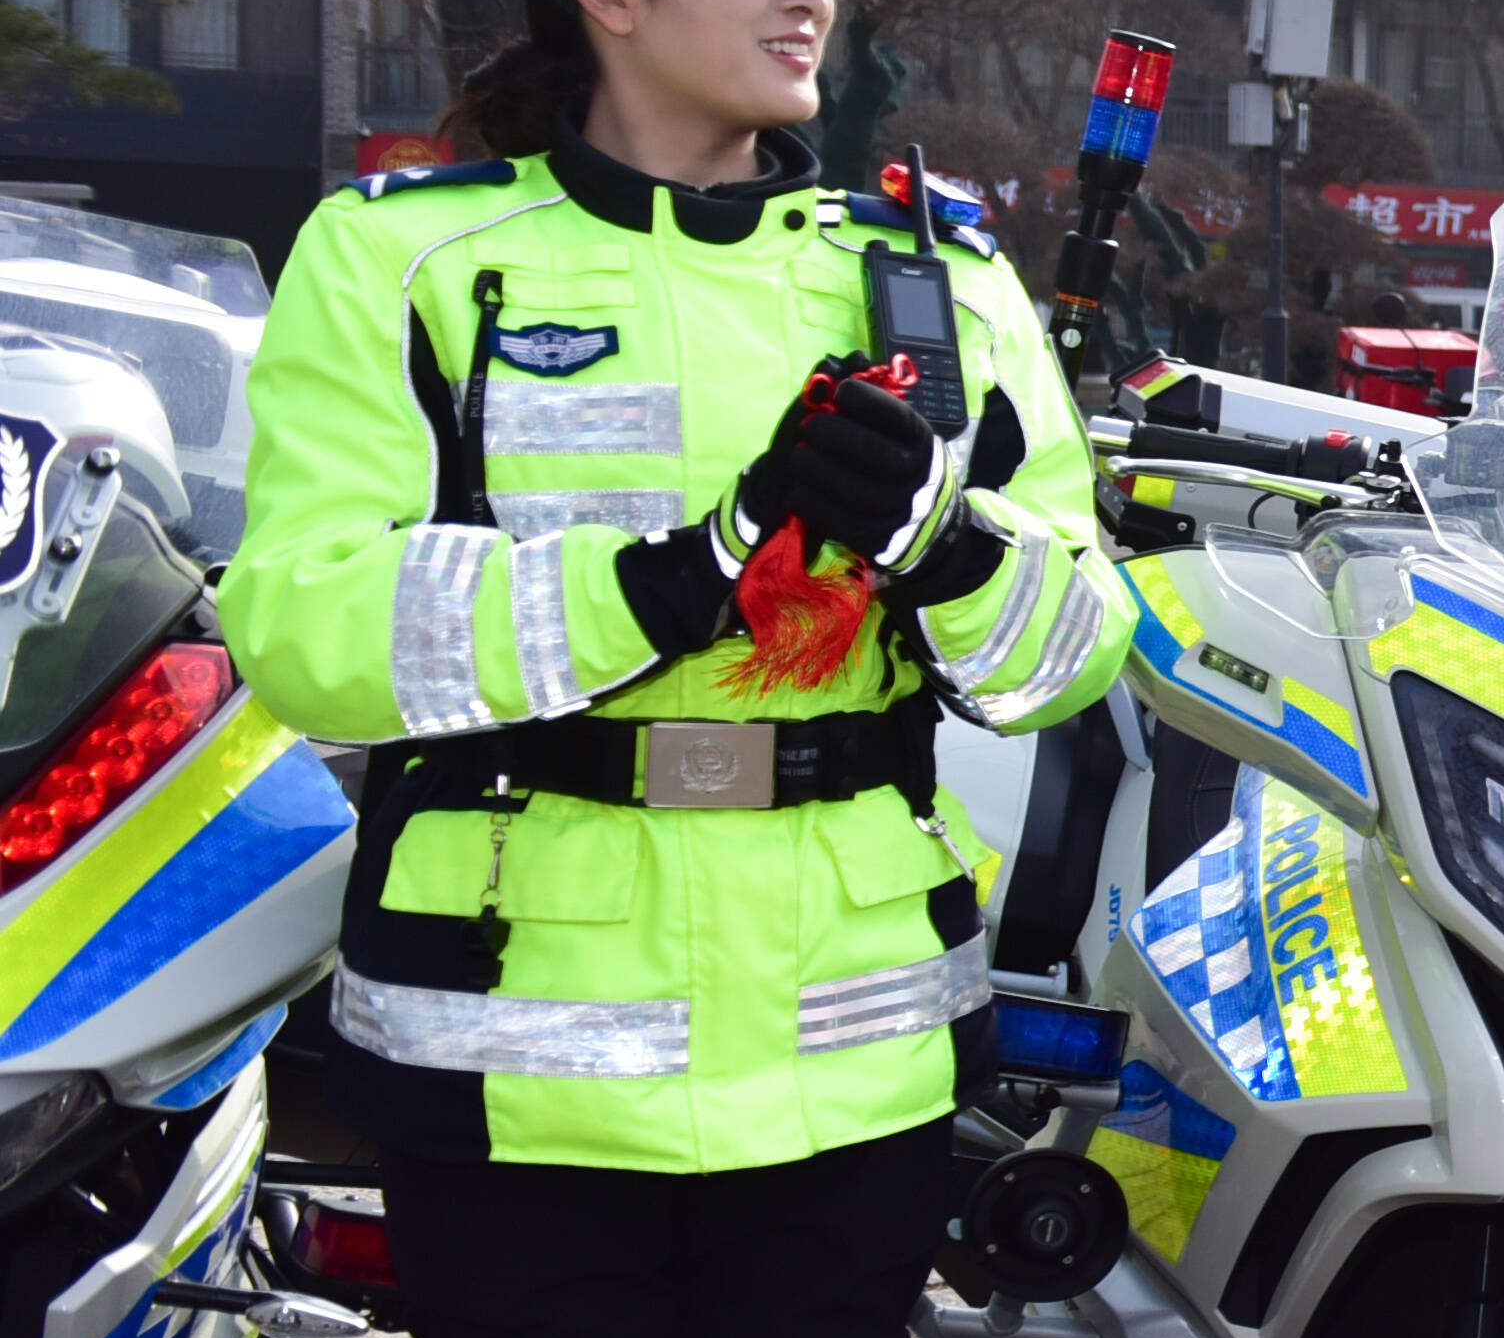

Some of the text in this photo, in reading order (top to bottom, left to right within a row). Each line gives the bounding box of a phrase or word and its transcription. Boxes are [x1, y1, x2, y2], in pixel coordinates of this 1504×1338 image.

[1345, 193, 1475, 236] 超市
[470, 372, 484, 419] POLICE
[1264, 813, 1338, 1005] POLICE
